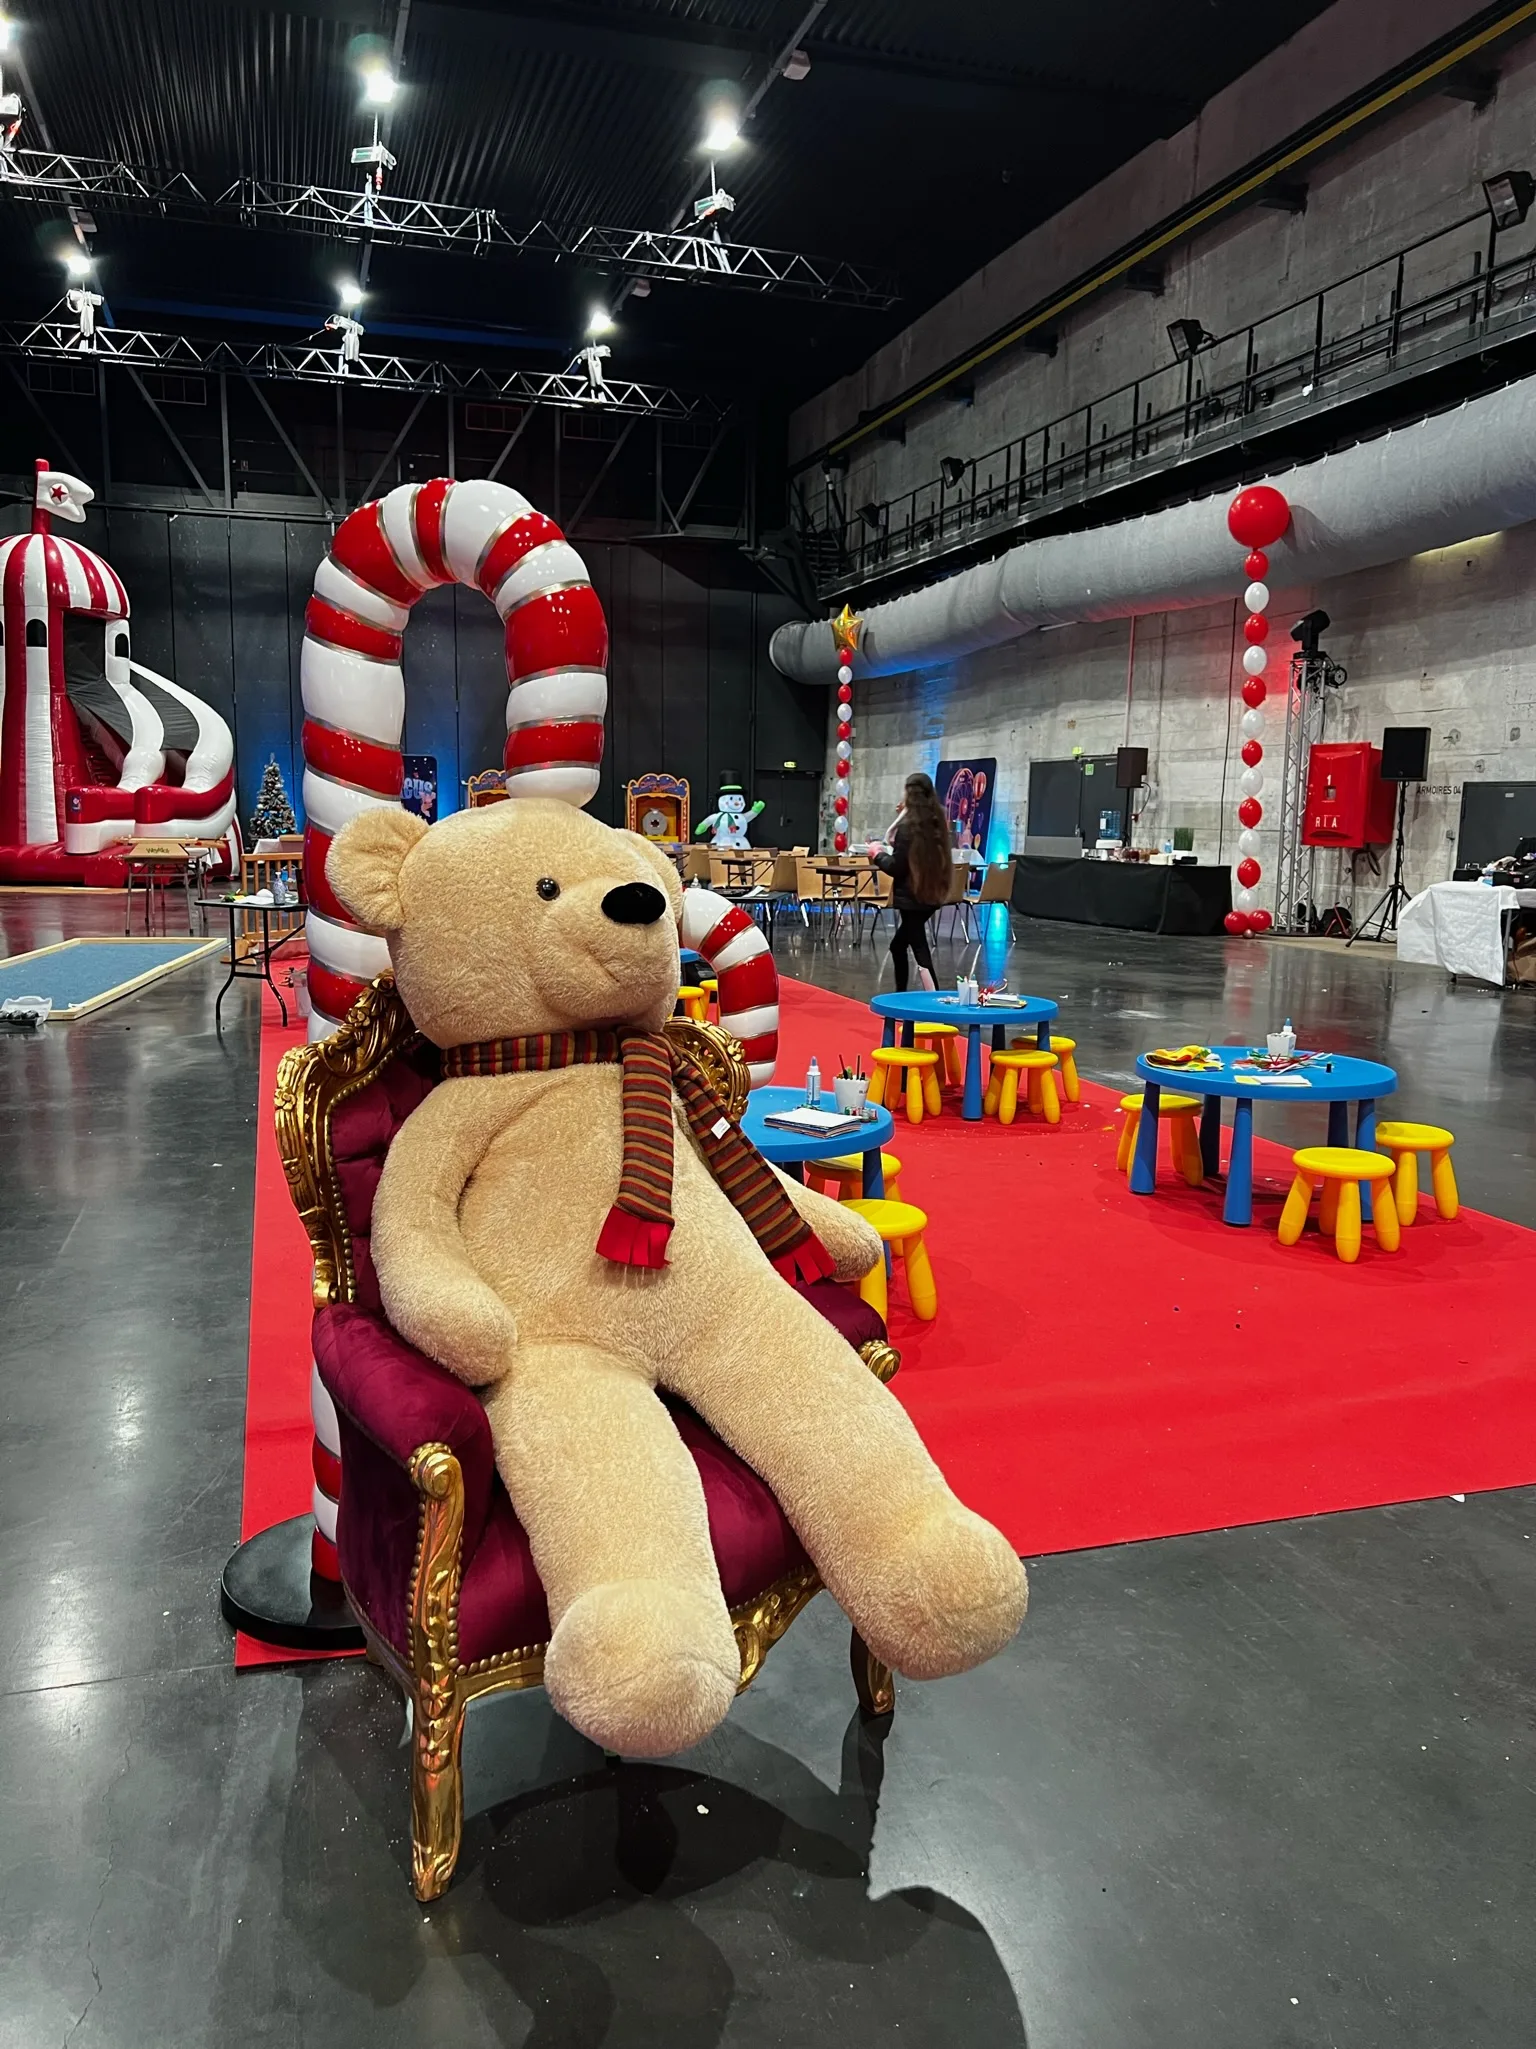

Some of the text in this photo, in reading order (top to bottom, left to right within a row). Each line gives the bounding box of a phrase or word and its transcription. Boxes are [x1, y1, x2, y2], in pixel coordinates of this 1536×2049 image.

[1326, 774, 1332, 786] 1
[400, 777, 433, 799] eus
[1416, 785, 1461, 795] ARMOIRES 04
